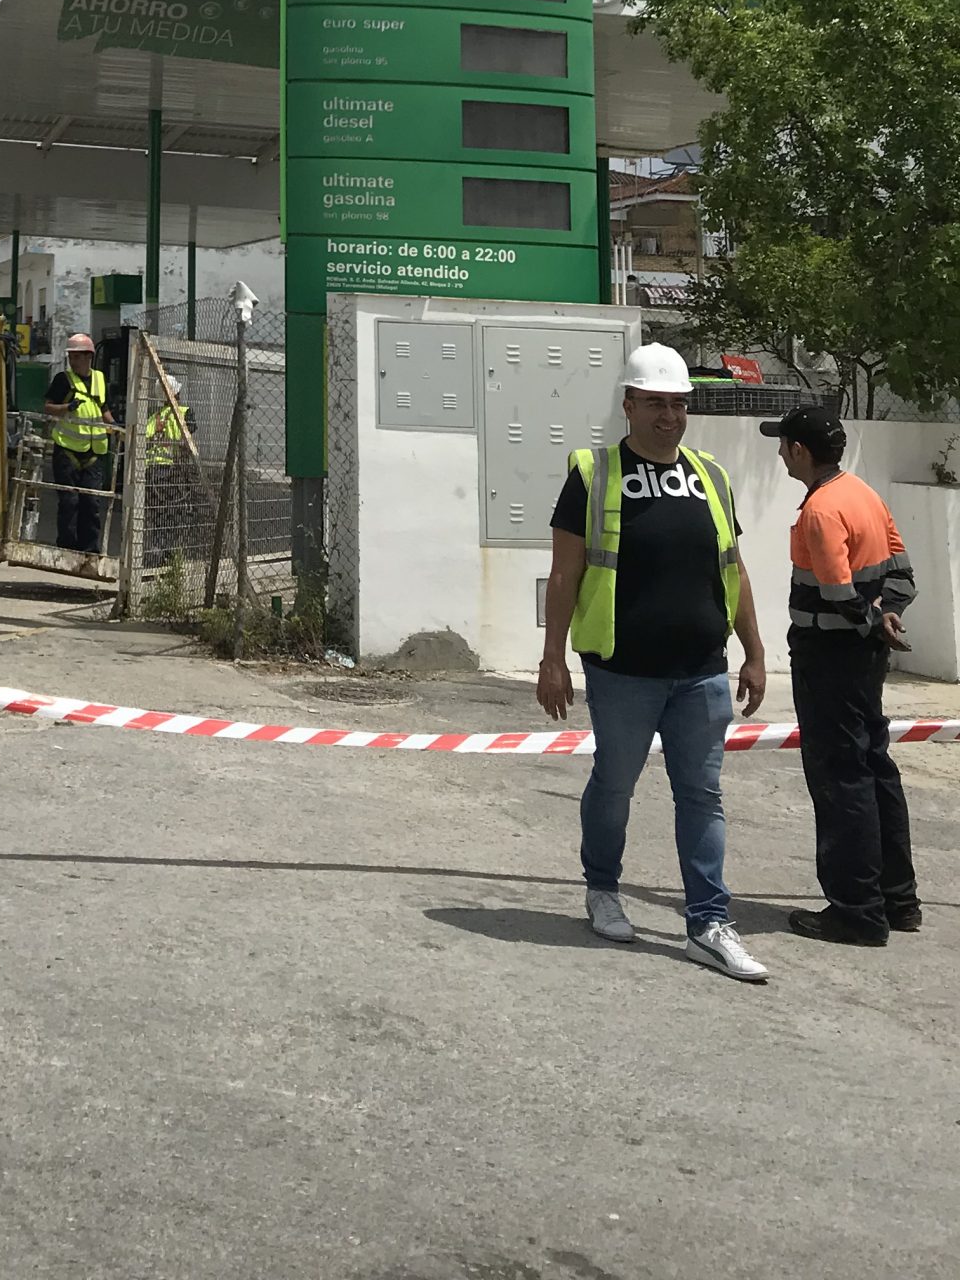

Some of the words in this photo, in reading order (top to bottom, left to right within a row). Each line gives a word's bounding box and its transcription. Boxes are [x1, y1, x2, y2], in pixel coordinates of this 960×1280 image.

[63, 16, 82, 33] A
[89, 14, 123, 34] TU
[129, 19, 234, 48] MEDIDA
[323, 19, 356, 29] euro
[363, 19, 405, 32] super
[323, 96, 394, 112] ultimate
[323, 114, 373, 129] diesel
[366, 134, 373, 142] A
[323, 172, 394, 189] ultimate
[323, 191, 396, 208] gasolina
[327, 239, 393, 256] horario:
[398, 243, 419, 257] de
[423, 244, 457, 260] 6:00
[461, 249, 470, 260] a
[475, 247, 516, 263] 22:00
[326, 260, 392, 276] servicio
[397, 264, 469, 280] atendido
